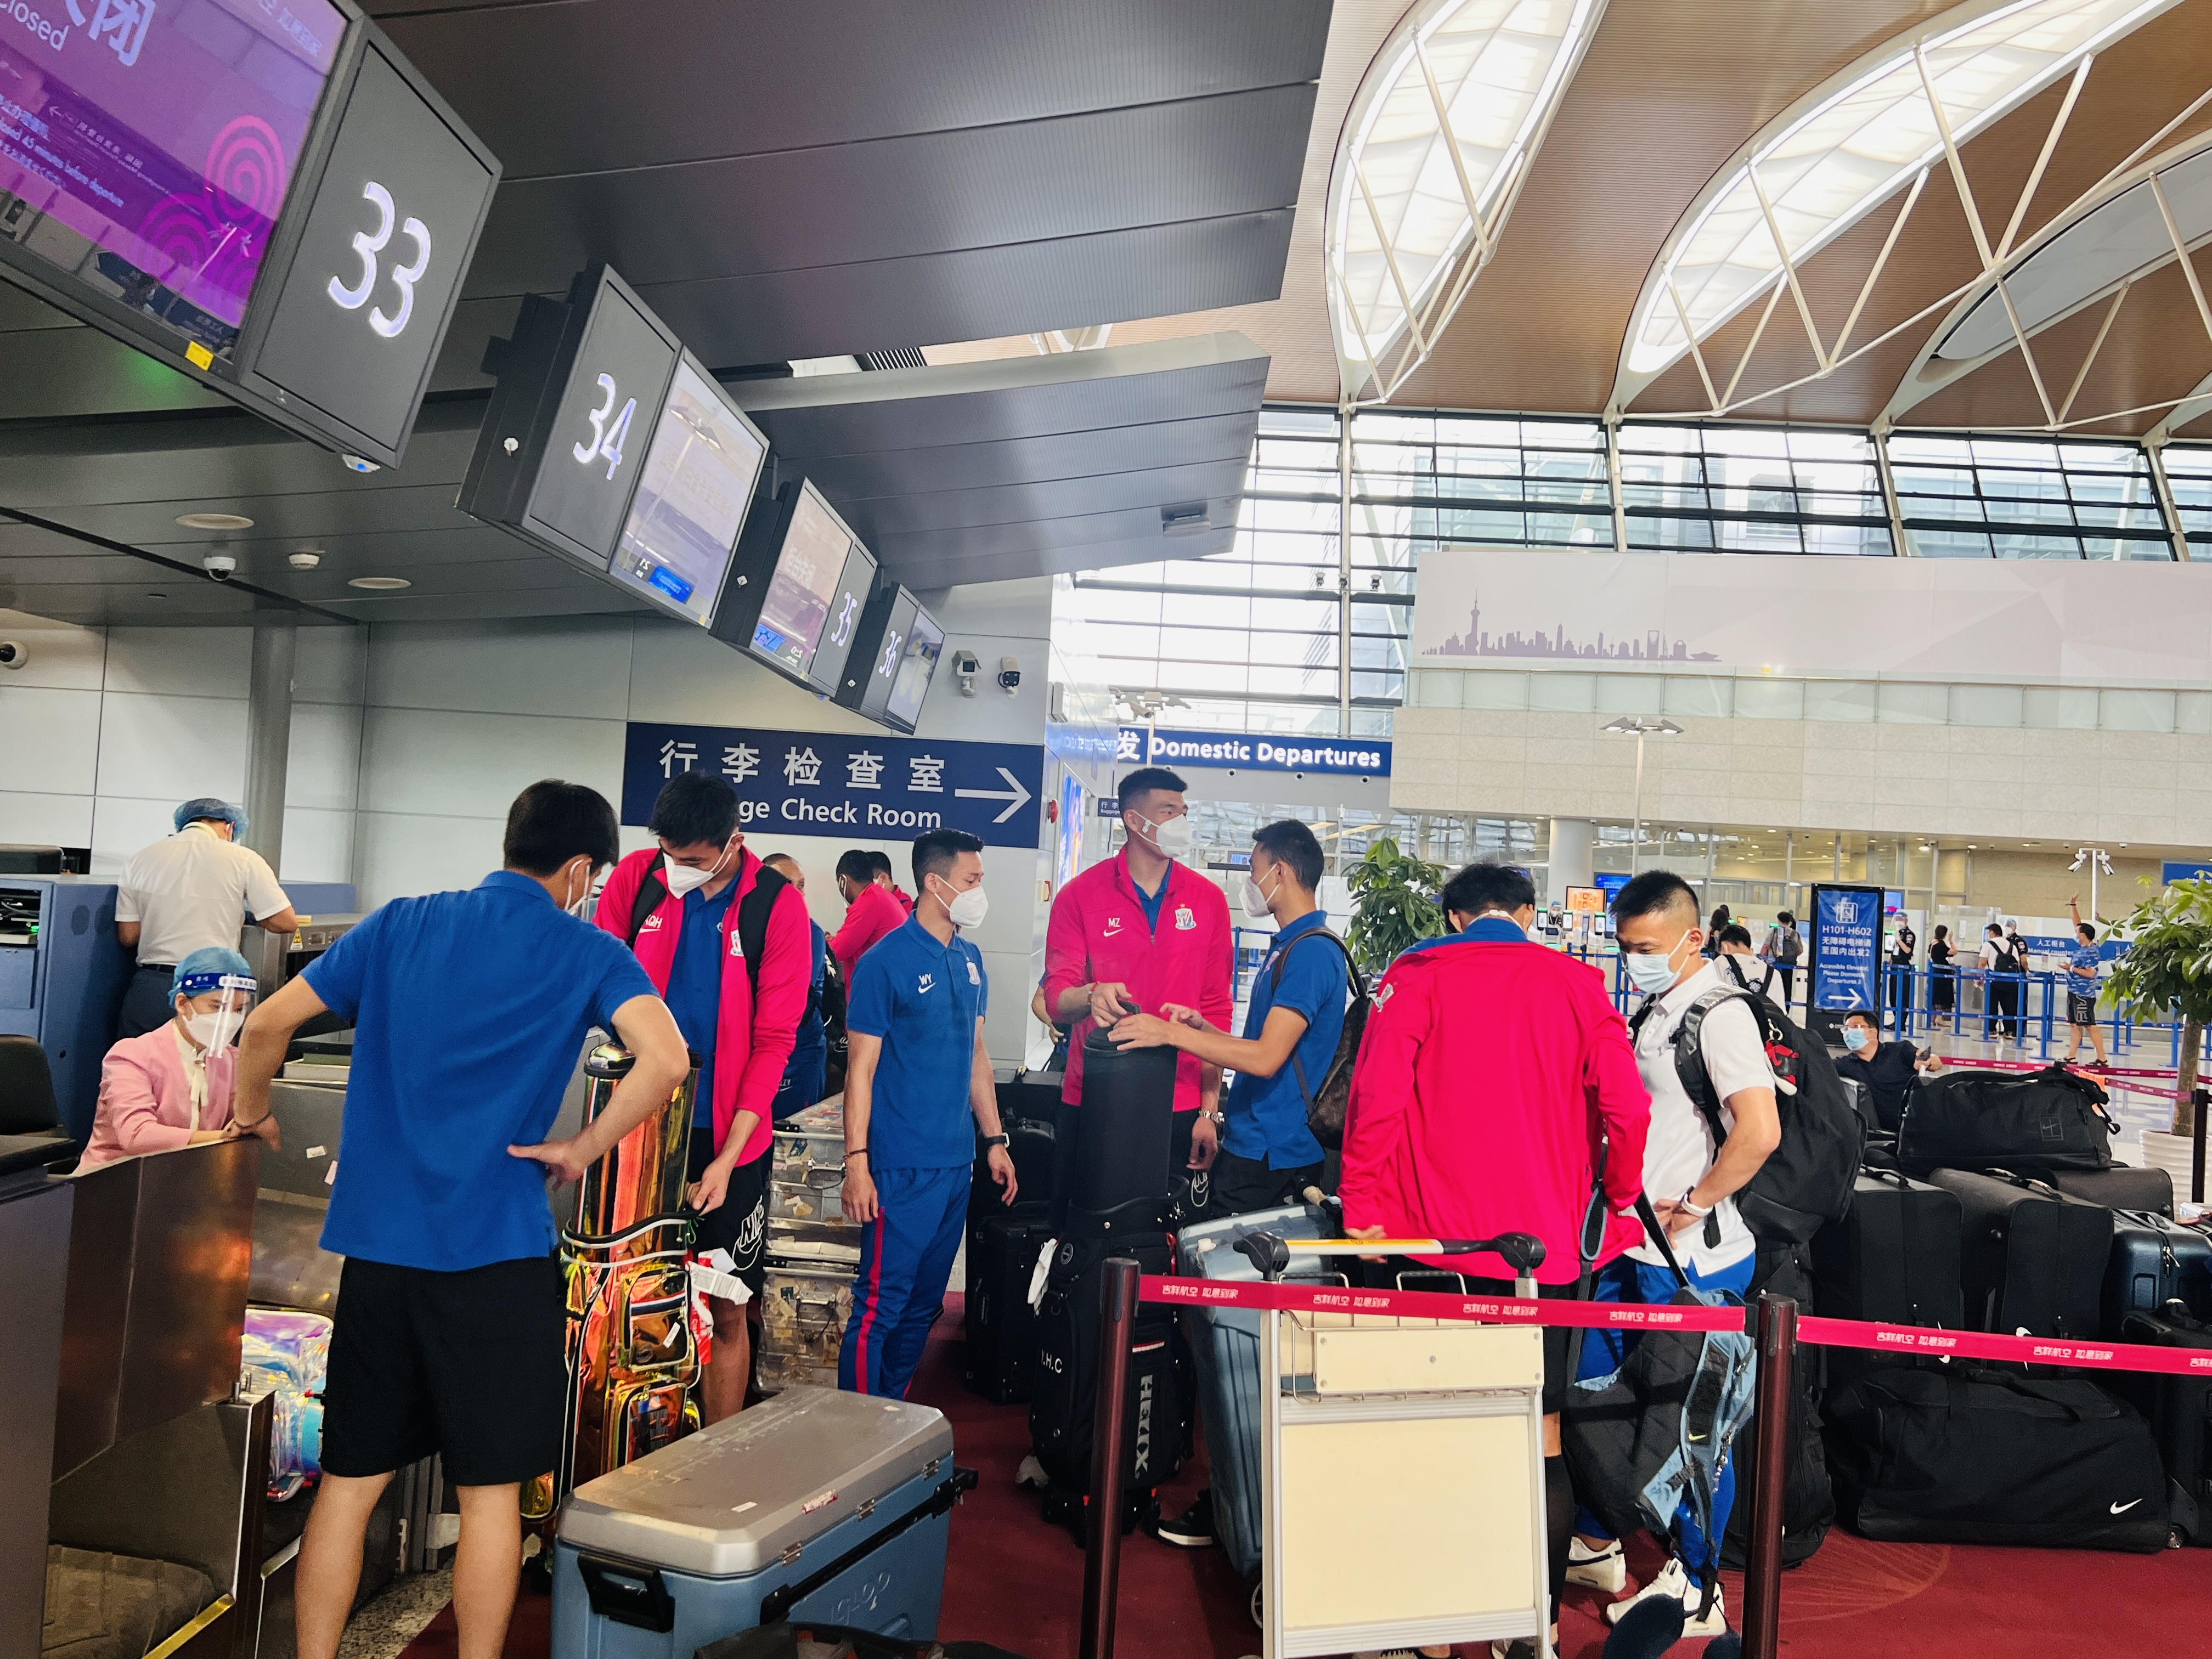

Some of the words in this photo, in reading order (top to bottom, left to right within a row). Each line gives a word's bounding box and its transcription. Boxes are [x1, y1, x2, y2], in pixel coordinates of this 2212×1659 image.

[327, 181, 431, 338] 33
[573, 373, 636, 481] 34
[831, 592, 858, 647] 35
[879, 630, 902, 678] 36
[1151, 737, 1251, 761] Domestic
[1257, 743, 1381, 768] Departures
[659, 738, 946, 793] 行李检查室
[781, 798, 858, 823] Check
[867, 803, 941, 828] Room
[1108, 917, 1121, 928] MZ
[1822, 925, 1872, 936] H101-H602
[1821, 946, 1870, 957] 至国内出发2
[2036, 939, 2065, 948] 人工柜台
[918, 973, 932, 985] WY
[1162, 1285, 1199, 1297] 吉祥航空
[1201, 1287, 1239, 1299] 如意到家
[1313, 1294, 1350, 1306] 吉祥航空
[1353, 1296, 1391, 1308] 如意到家
[2190, 1357, 2212, 1369] 吉祥
[1135, 1375, 1153, 1479] HELIX
